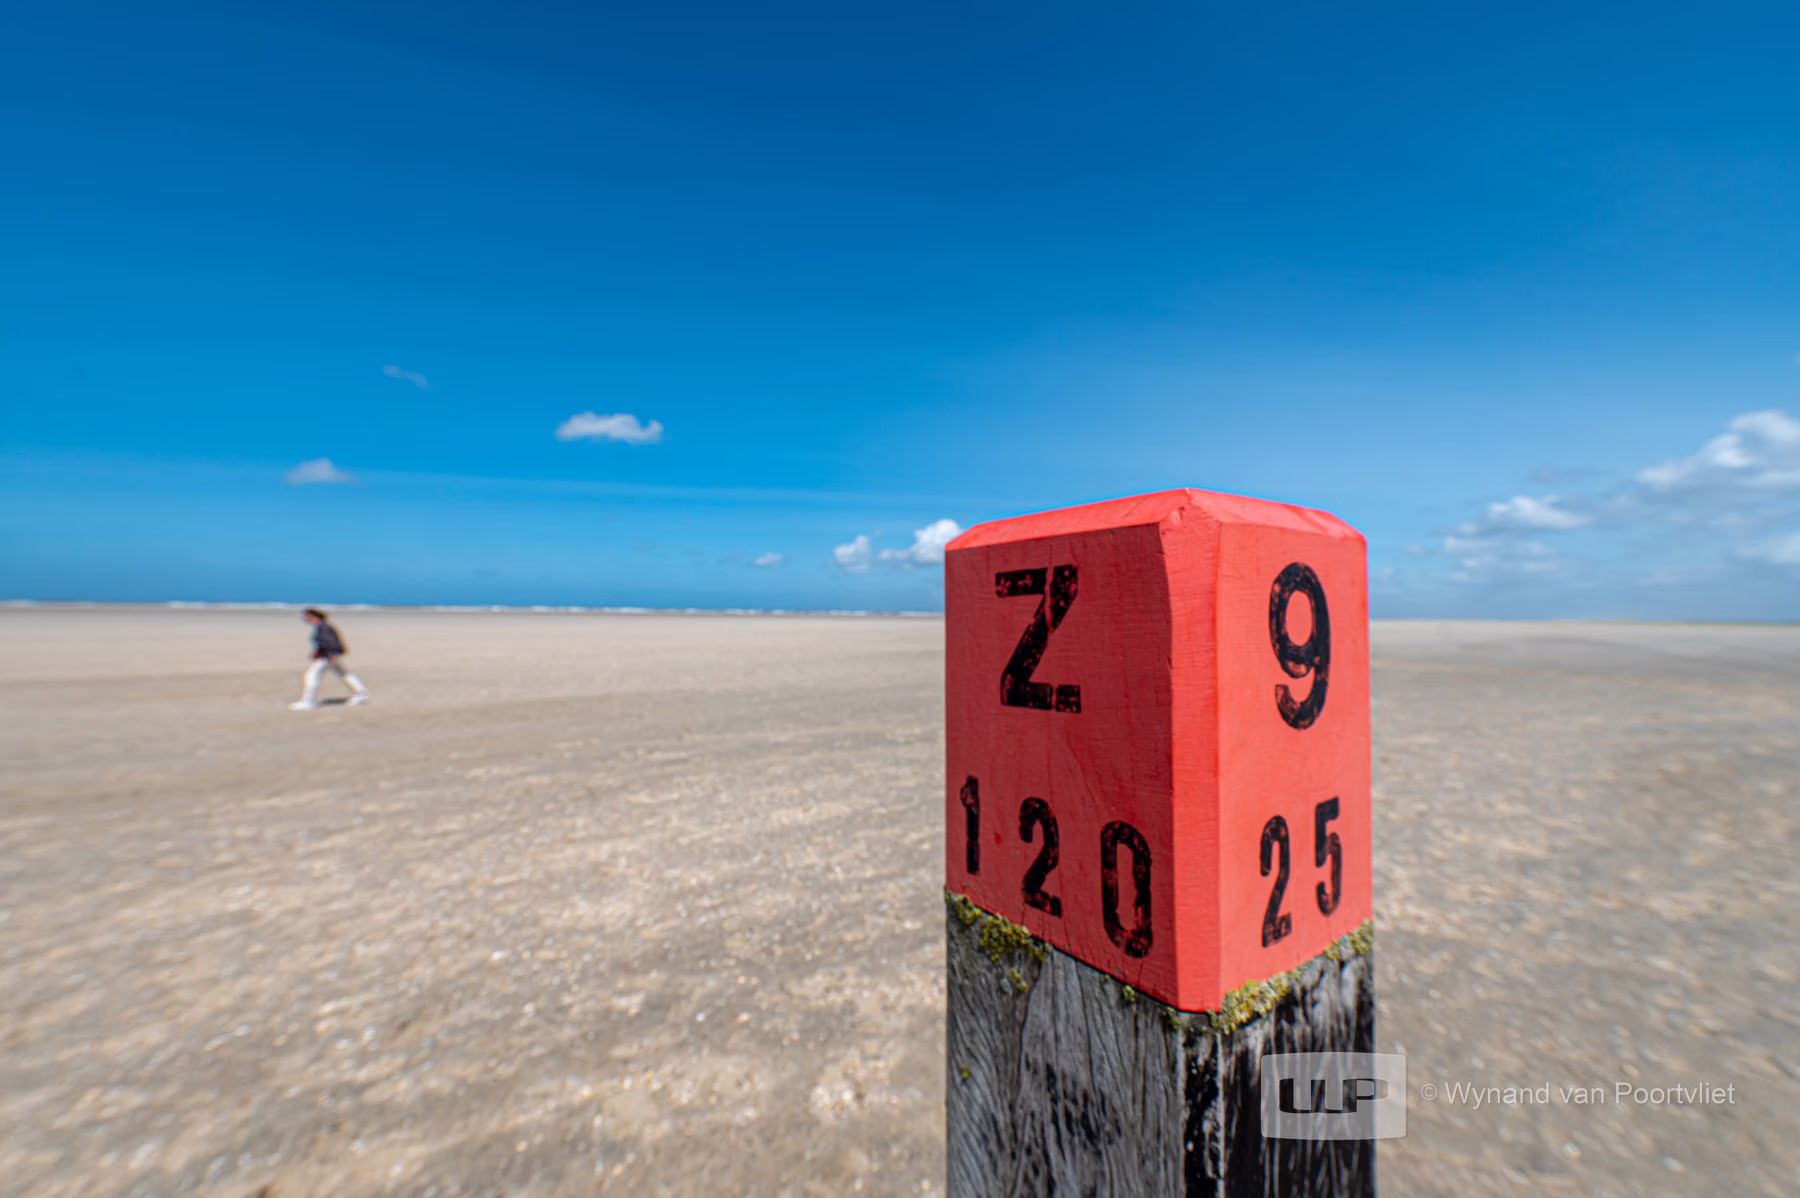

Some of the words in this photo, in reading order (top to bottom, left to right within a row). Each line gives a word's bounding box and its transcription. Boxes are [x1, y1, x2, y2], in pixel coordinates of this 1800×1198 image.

[995, 564, 1081, 713] Z
[1268, 562, 1331, 730] 9
[959, 775, 1153, 958] 120
[1259, 796, 1342, 948] 25
